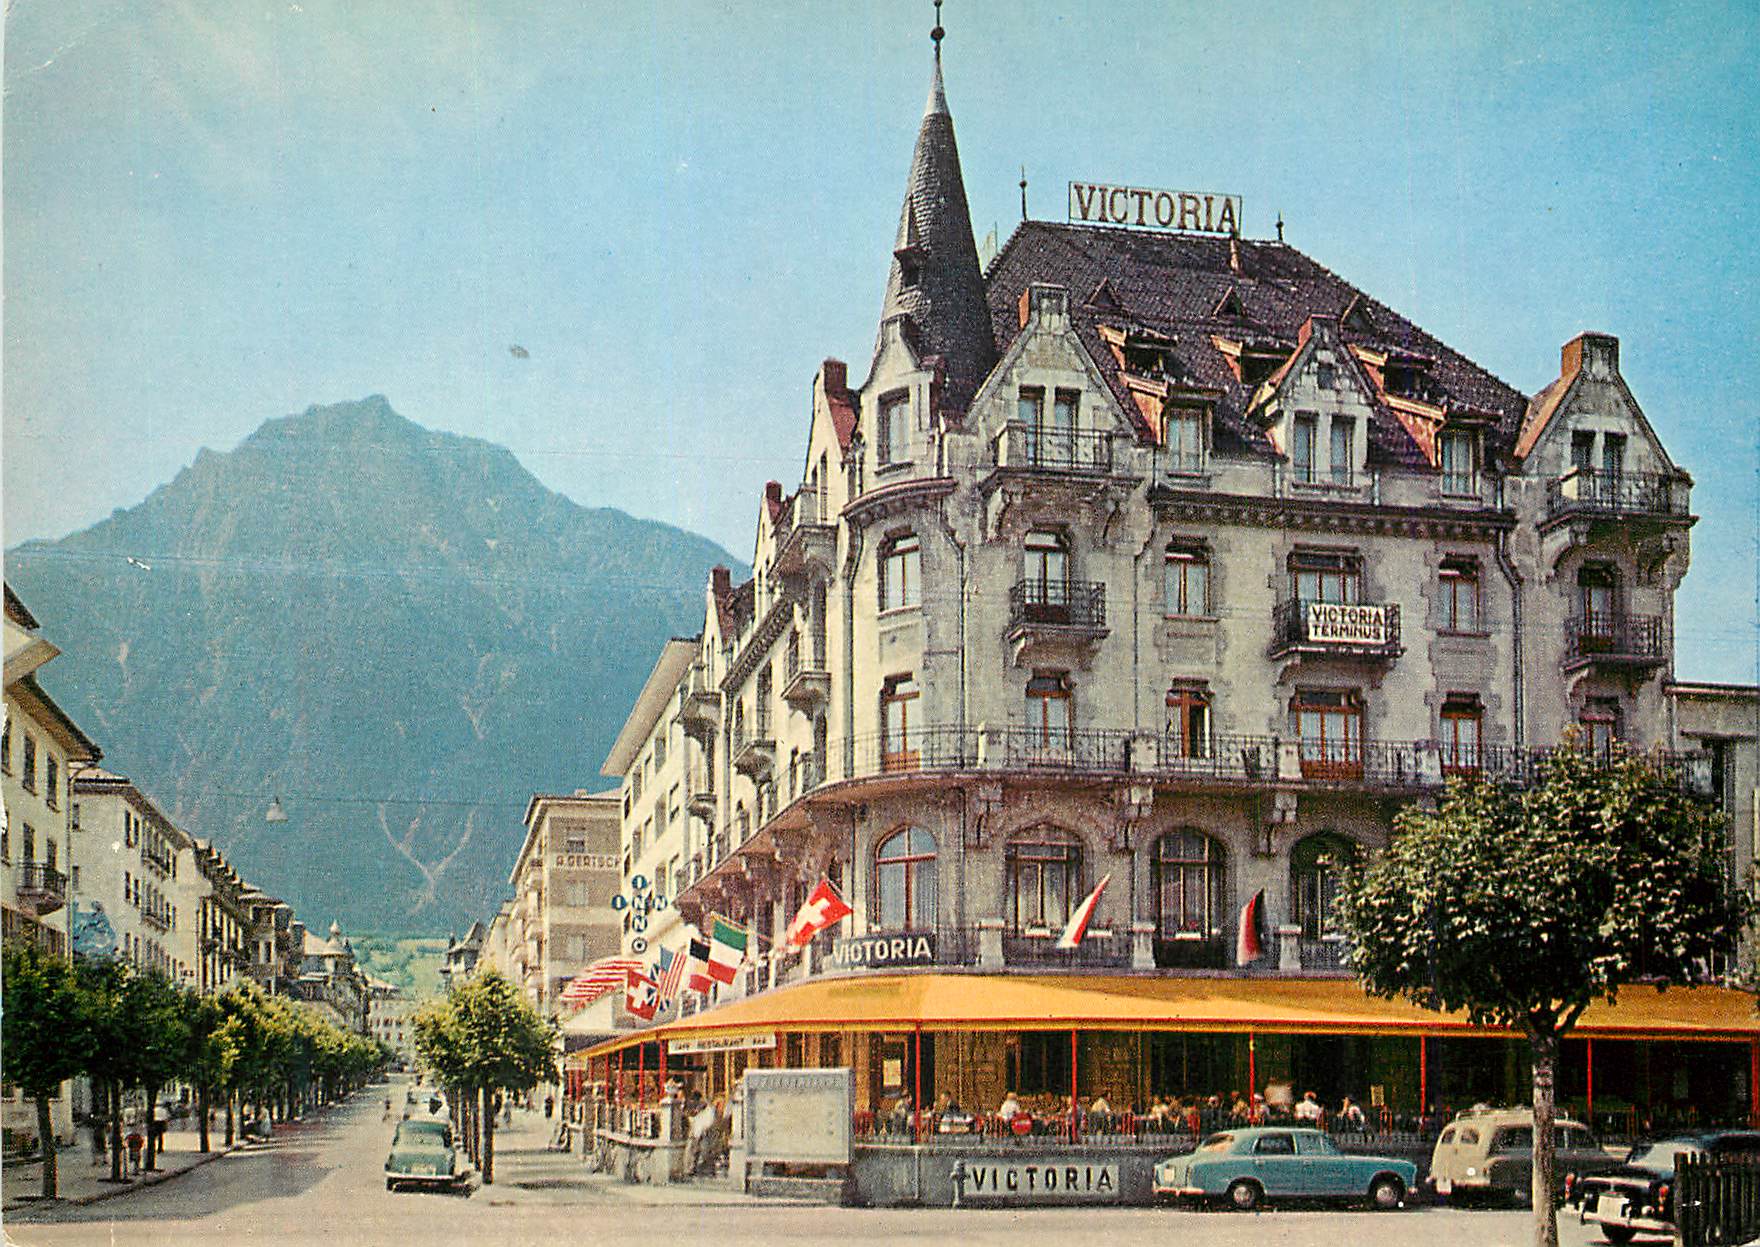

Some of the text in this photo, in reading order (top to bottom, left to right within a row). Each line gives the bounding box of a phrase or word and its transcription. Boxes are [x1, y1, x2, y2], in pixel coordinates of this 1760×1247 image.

[1073, 183, 1238, 234] VICTORIA
[1311, 605, 1384, 626] VICTORIA
[1312, 624, 1382, 640] TERMINUS
[832, 937, 932, 964] VICTORIA
[972, 1166, 1113, 1192] VICTORIA
